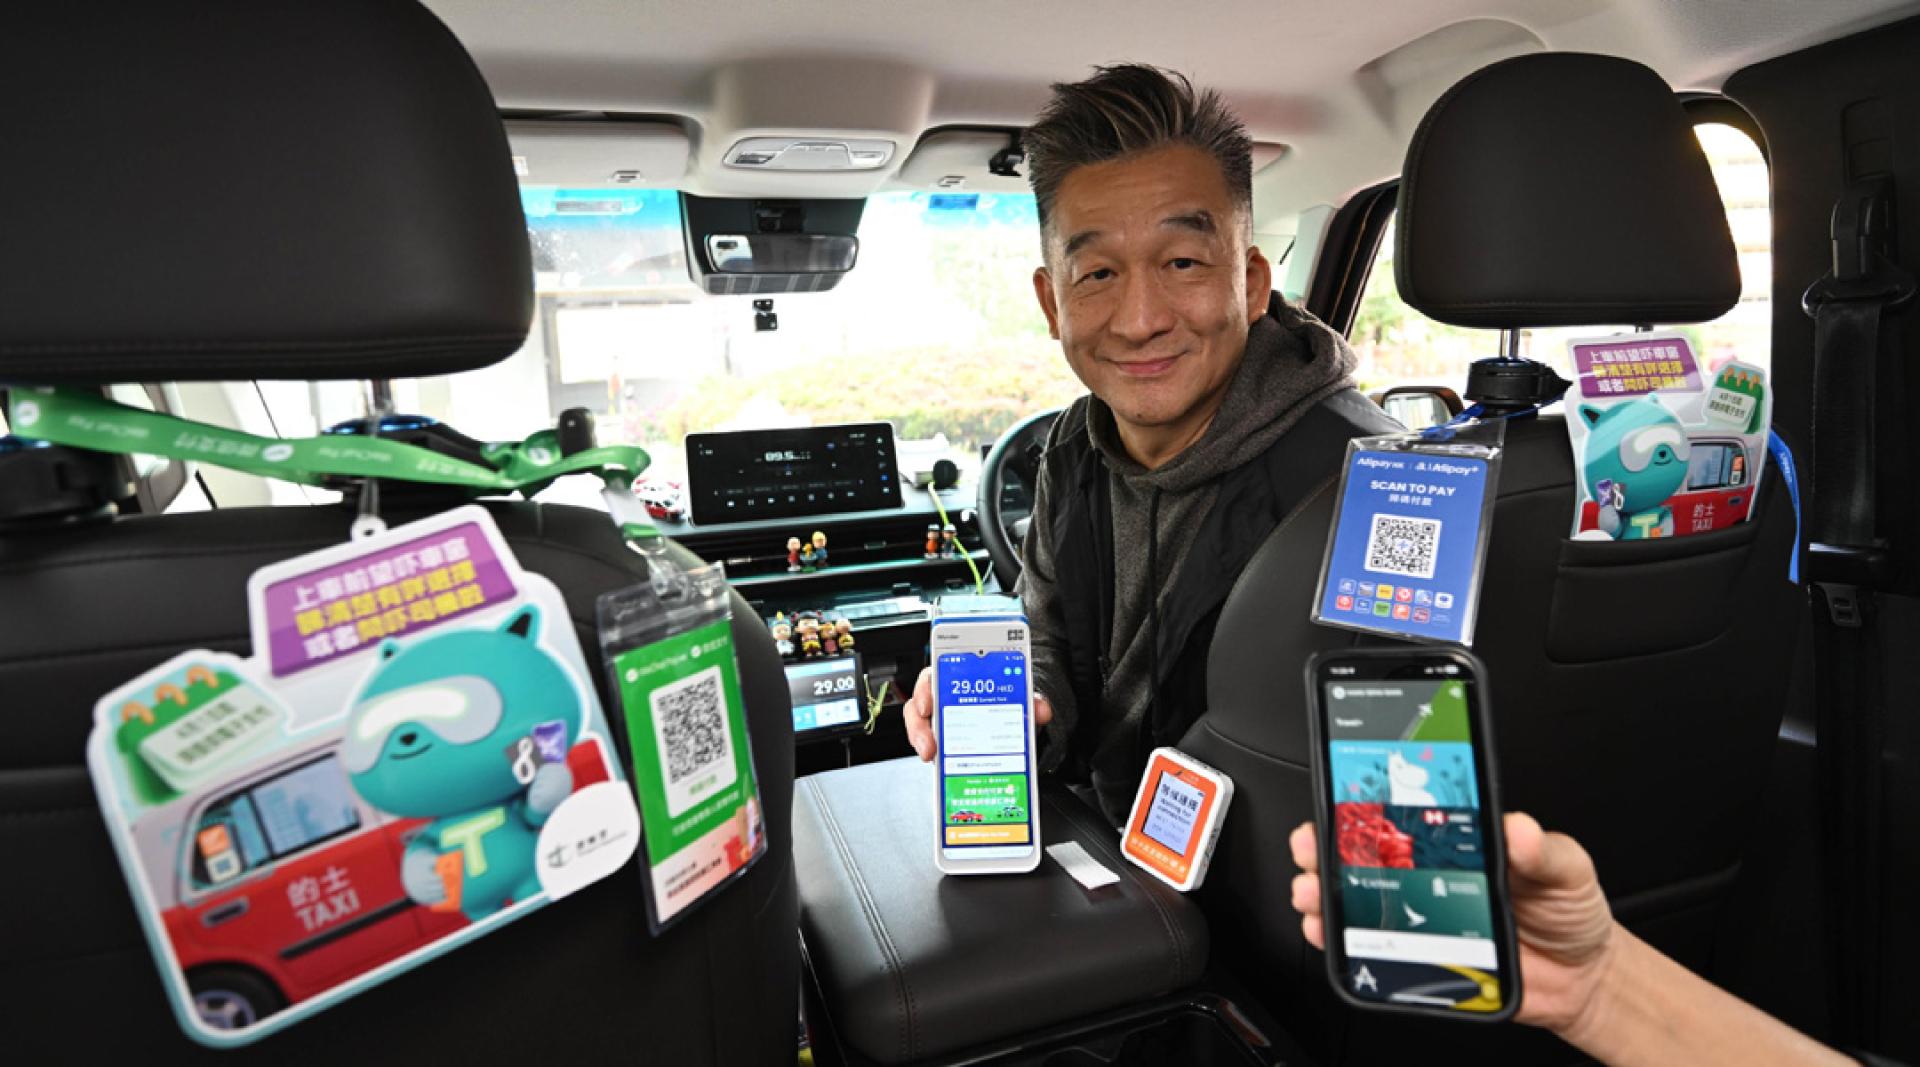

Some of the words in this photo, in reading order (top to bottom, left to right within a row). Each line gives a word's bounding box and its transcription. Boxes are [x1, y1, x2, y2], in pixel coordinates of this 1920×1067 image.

[1370, 480, 1407, 493] SCAN
[1409, 483, 1426, 494] TO
[1428, 485, 1456, 496] PAY
[1693, 502, 1715, 518] 的士
[1692, 518, 1713, 532] TAXI
[813, 676, 855, 696] 29.00
[951, 679, 995, 695] 29.00
[440, 807, 506, 877] T
[287, 866, 351, 906] 的士
[295, 888, 360, 930] TAXI
